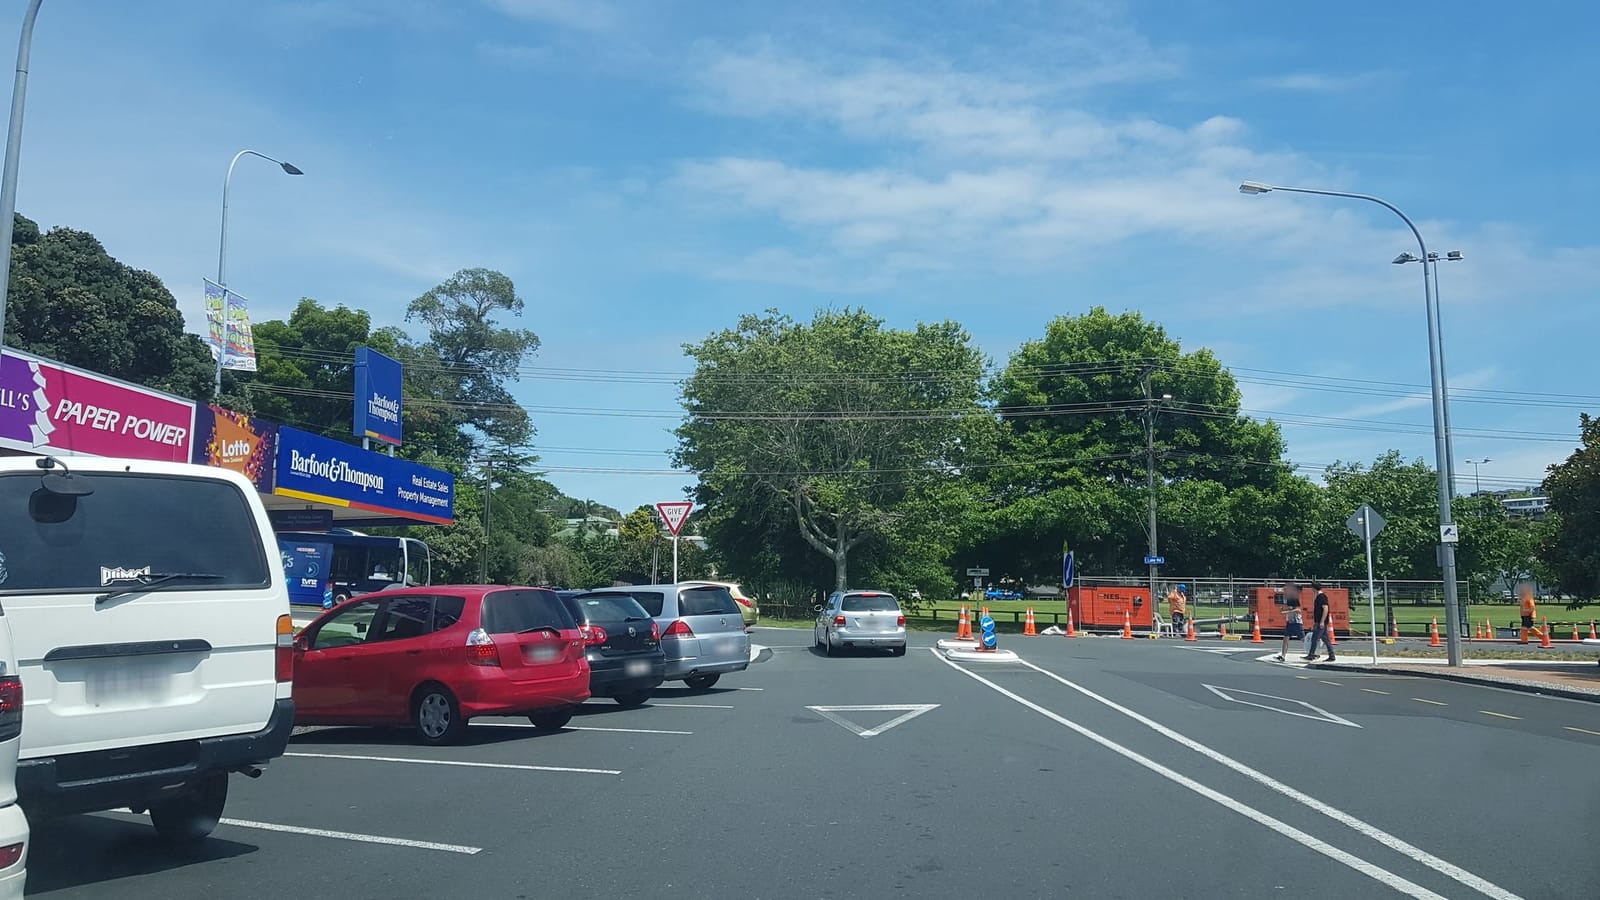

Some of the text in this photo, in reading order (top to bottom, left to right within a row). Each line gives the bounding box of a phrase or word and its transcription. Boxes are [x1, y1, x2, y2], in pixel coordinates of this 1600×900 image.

[0, 388, 186, 447] LL'S PAPER POWER
[368, 399, 398, 422] Thompson
[222, 440, 250, 457] Lotto
[412, 475, 449, 493] Real Estate Sales
[397, 487, 449, 507] Property Management
